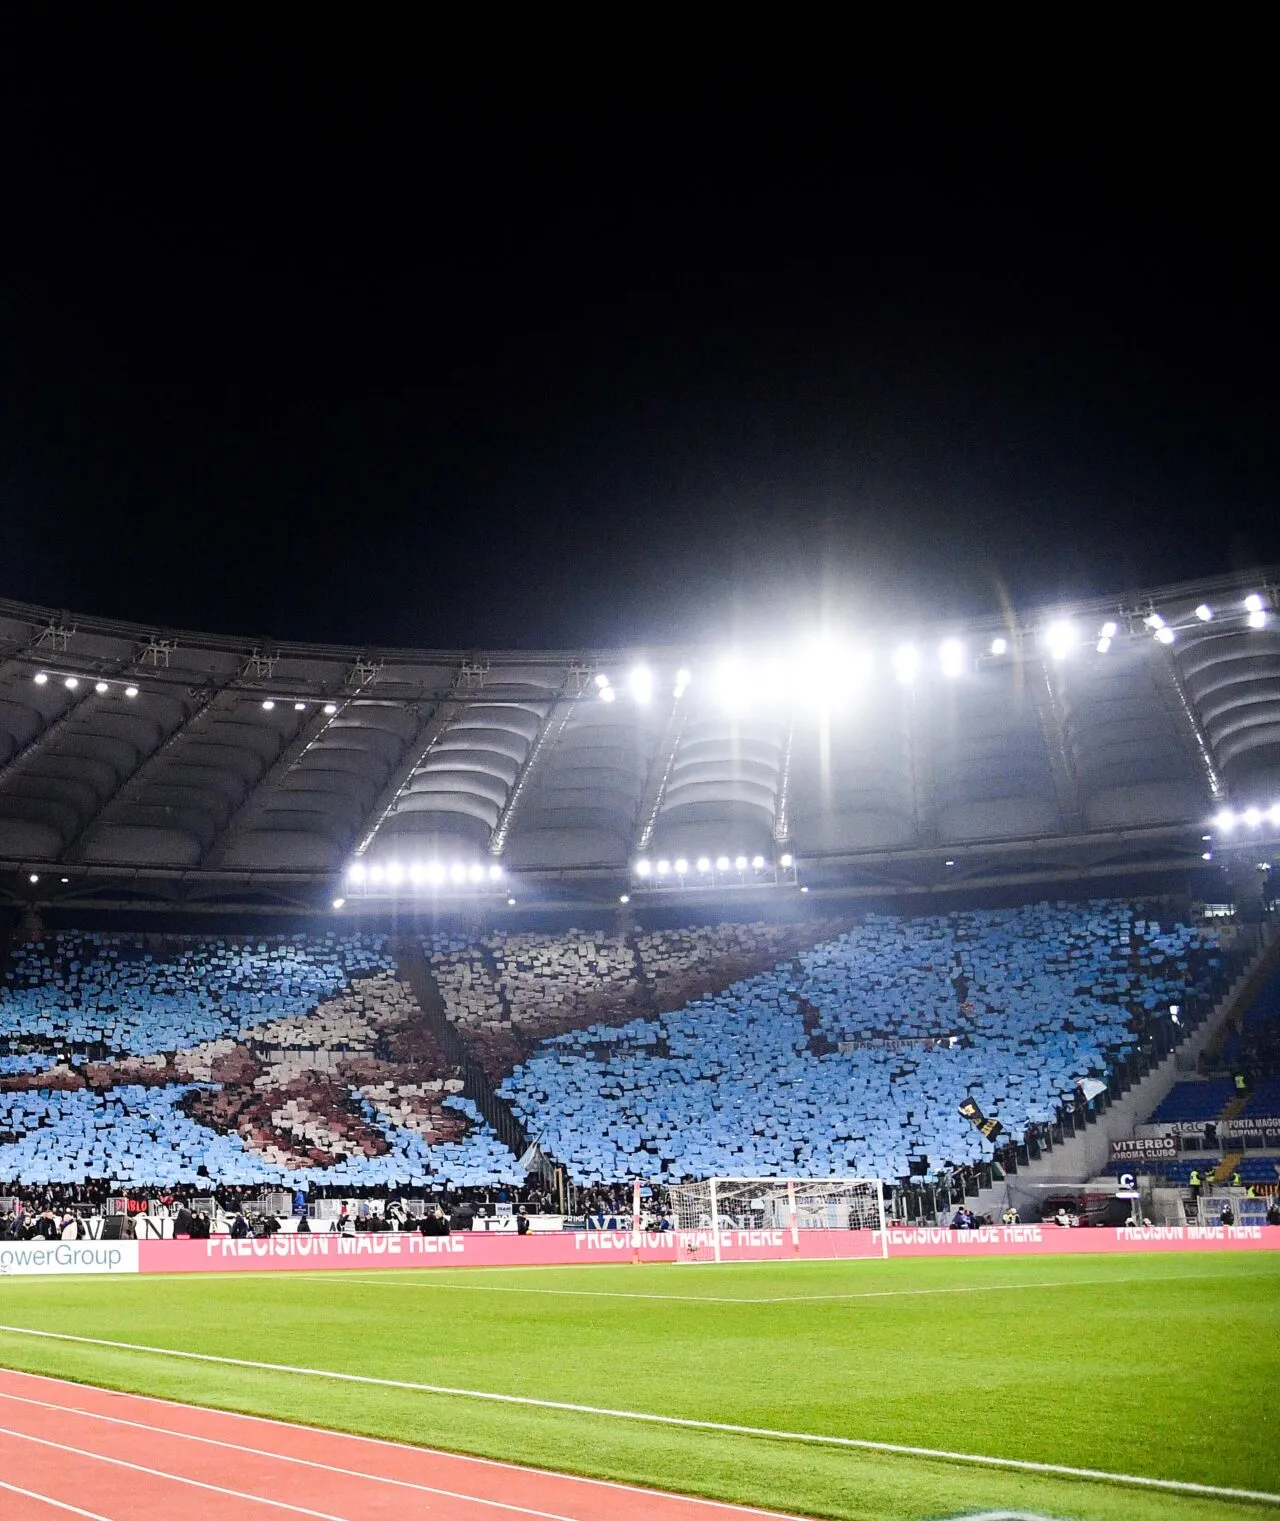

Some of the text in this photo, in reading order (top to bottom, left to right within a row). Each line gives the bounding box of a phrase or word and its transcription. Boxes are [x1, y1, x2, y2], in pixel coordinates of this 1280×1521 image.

[1112, 1139, 1174, 1151] VITERBO
[1120, 1149, 1168, 1159] ROMA CLUB
[575, 1233, 674, 1249] PRECIION
